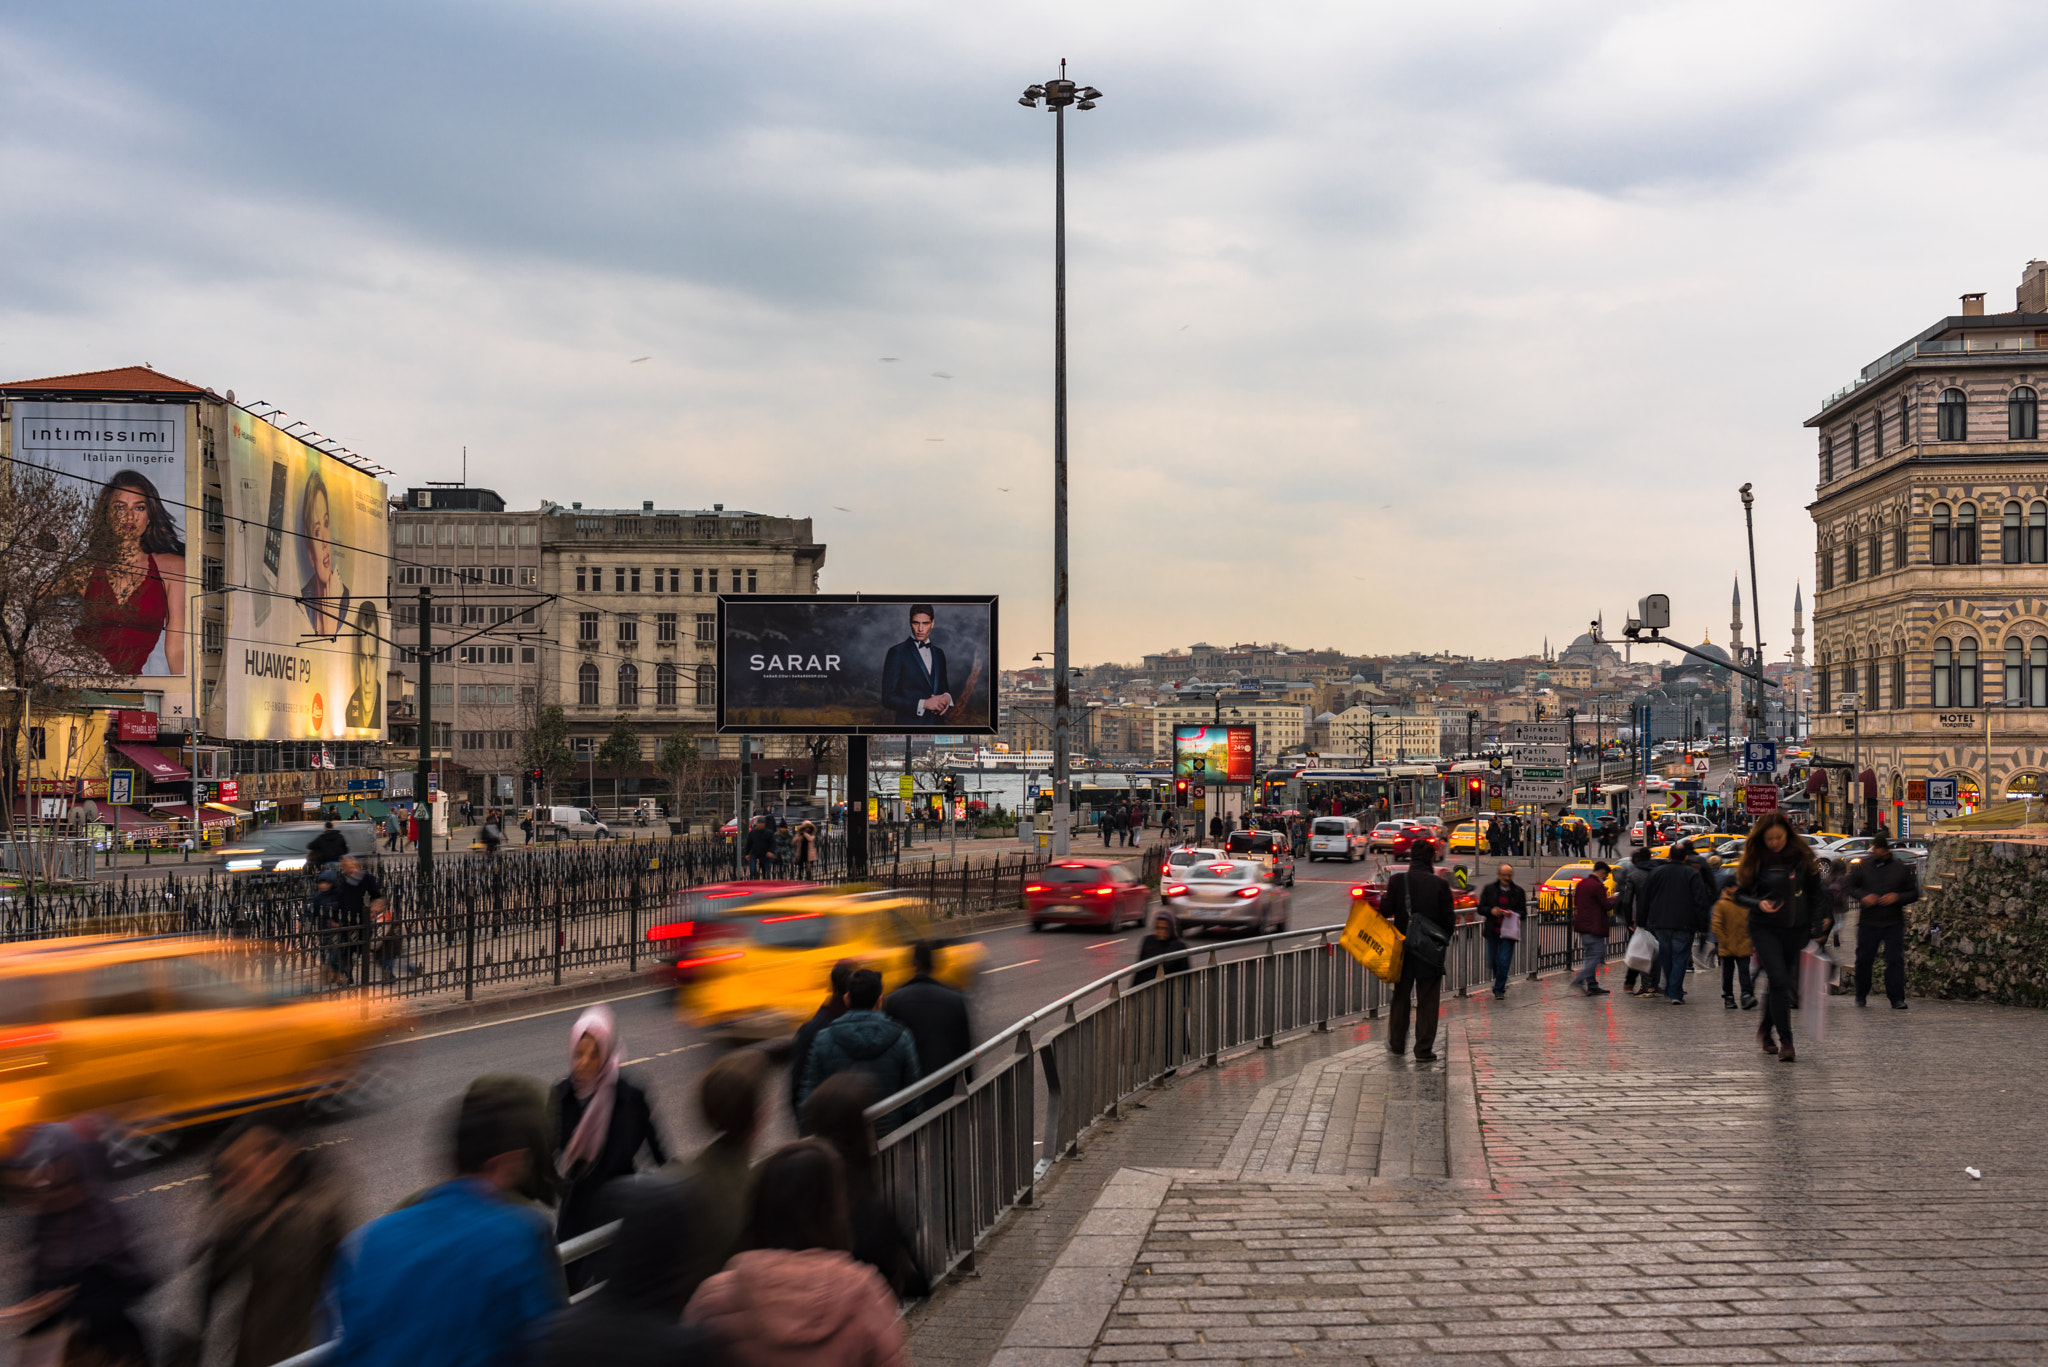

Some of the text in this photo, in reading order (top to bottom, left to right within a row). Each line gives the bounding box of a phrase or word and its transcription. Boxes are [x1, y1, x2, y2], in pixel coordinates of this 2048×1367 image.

[83, 453, 174, 465] Italian lingerie
[245, 649, 311, 683] HUAWEI P9
[750, 654, 841, 671] SARAR
[1940, 714, 1975, 723] HOTEL
[1747, 761, 1774, 771] EDS
[1523, 769, 1545, 777] Avrasya
[1515, 784, 1549, 792] Taksim
